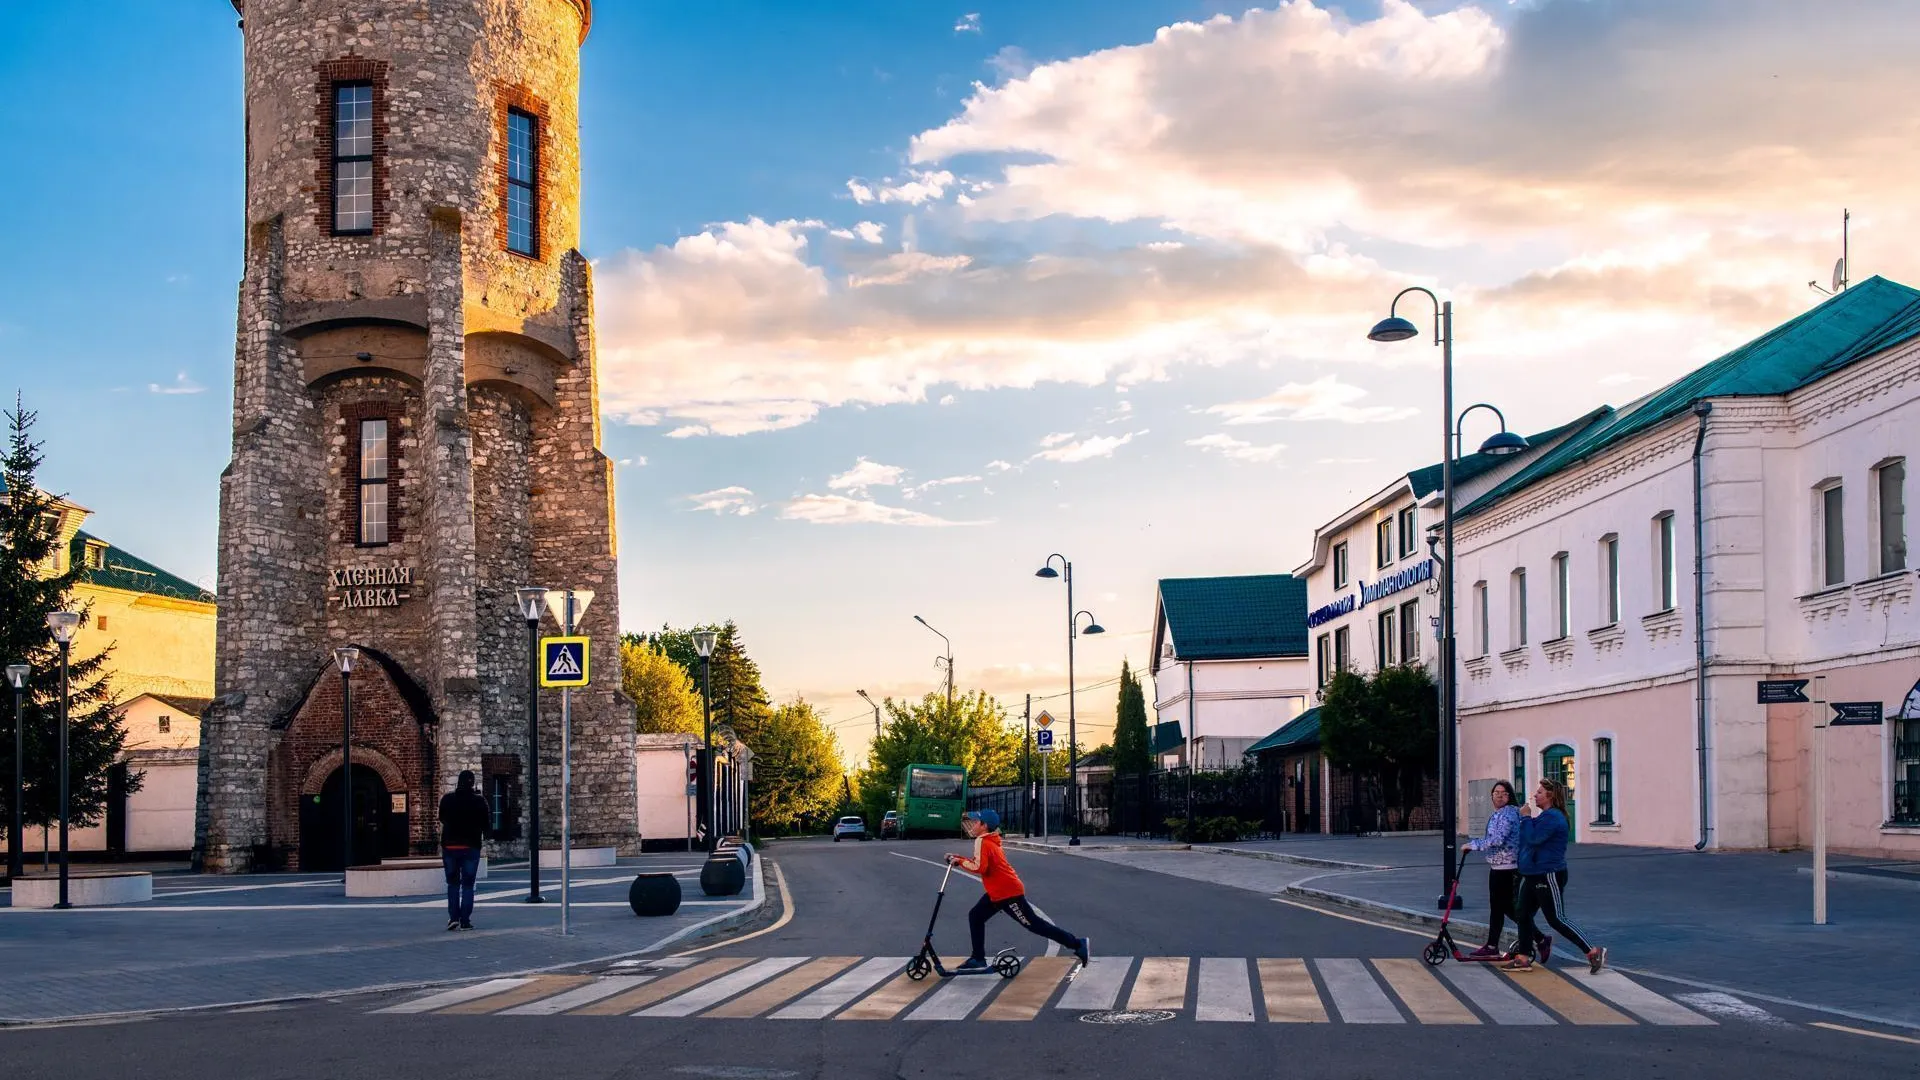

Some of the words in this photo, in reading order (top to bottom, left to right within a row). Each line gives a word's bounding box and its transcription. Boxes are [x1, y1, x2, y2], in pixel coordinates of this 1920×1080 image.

[329, 567, 411, 587] ХЛЕБНАЯ
[1363, 559, 1433, 605] ИМПЛАНТОЛОГИЯ
[1040, 732, 1050, 744] P
